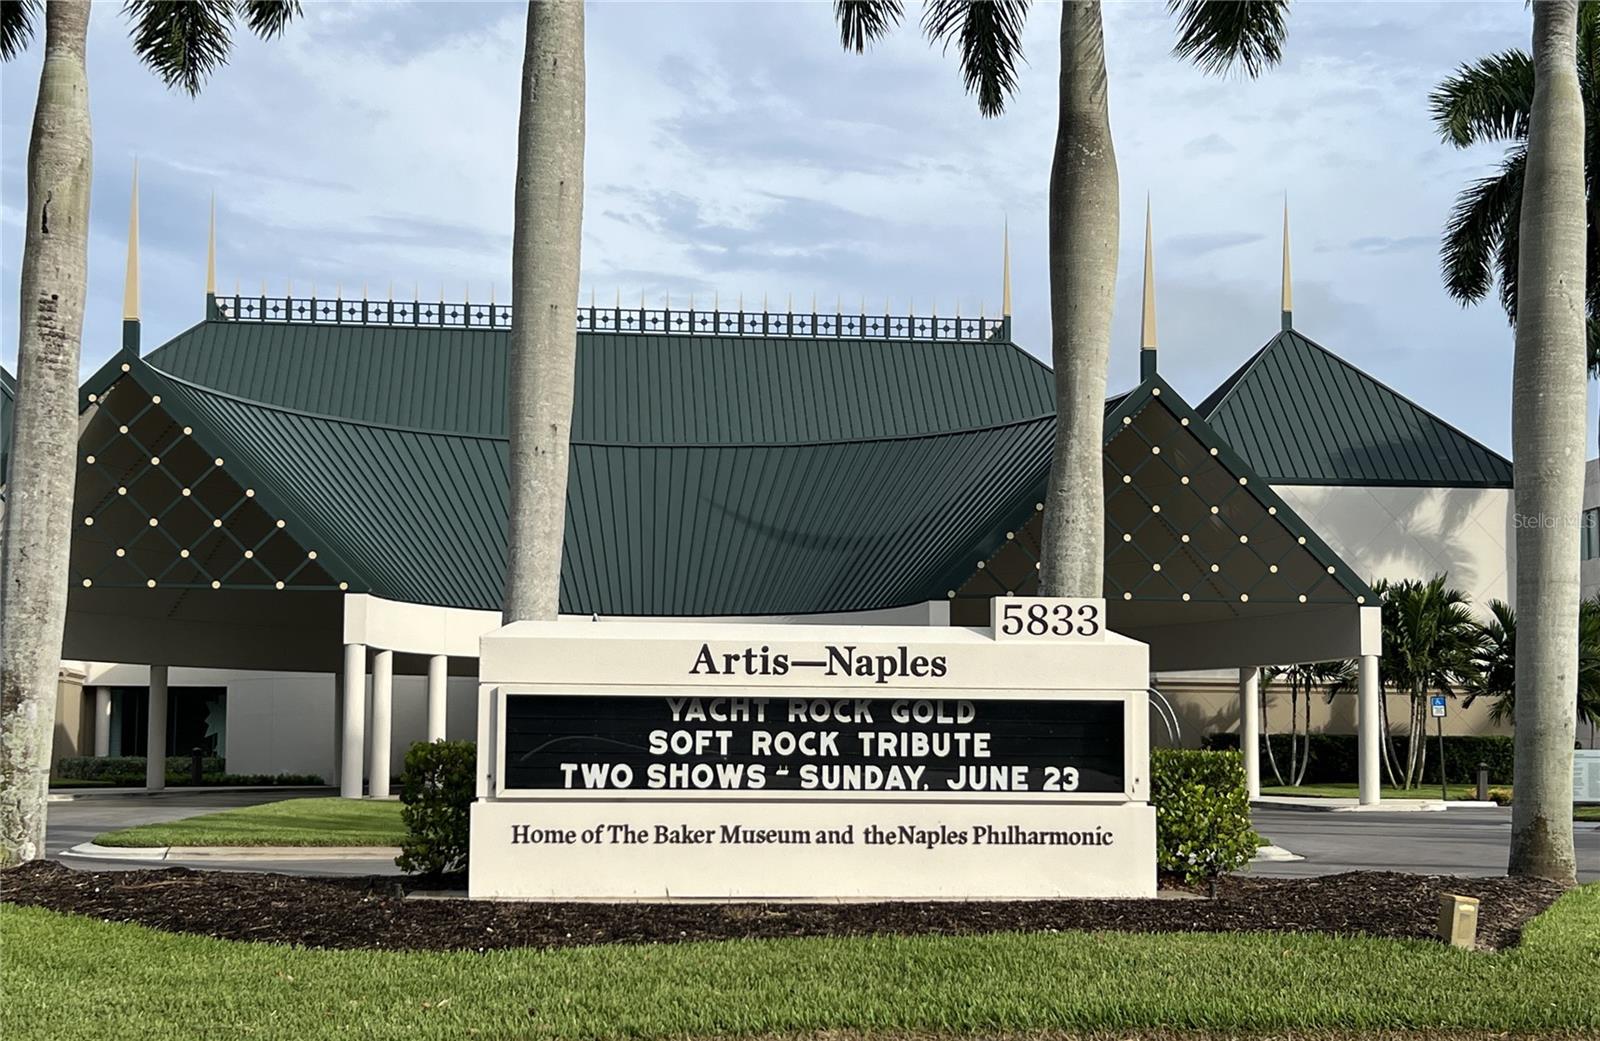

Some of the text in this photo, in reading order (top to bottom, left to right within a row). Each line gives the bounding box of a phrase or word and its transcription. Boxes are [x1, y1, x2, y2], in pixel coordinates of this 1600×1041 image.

[1002, 604, 1100, 636] 5833
[665, 697, 976, 725] YACHT ROCK GOLD
[649, 730, 991, 758] SOFT ROCK TRIBUTE
[560, 763, 634, 789] TWO
[647, 764, 767, 789] SHOWS
[946, 766, 1029, 791] JUNE
[1042, 767, 1080, 791] 23
[511, 824, 577, 845] Home
[581, 824, 605, 844] of
[607, 824, 649, 844] The
[653, 824, 716, 845] Baker
[720, 824, 812, 844] Museum
[815, 824, 854, 845] and
[972, 824, 1114, 846] Philharmonic
